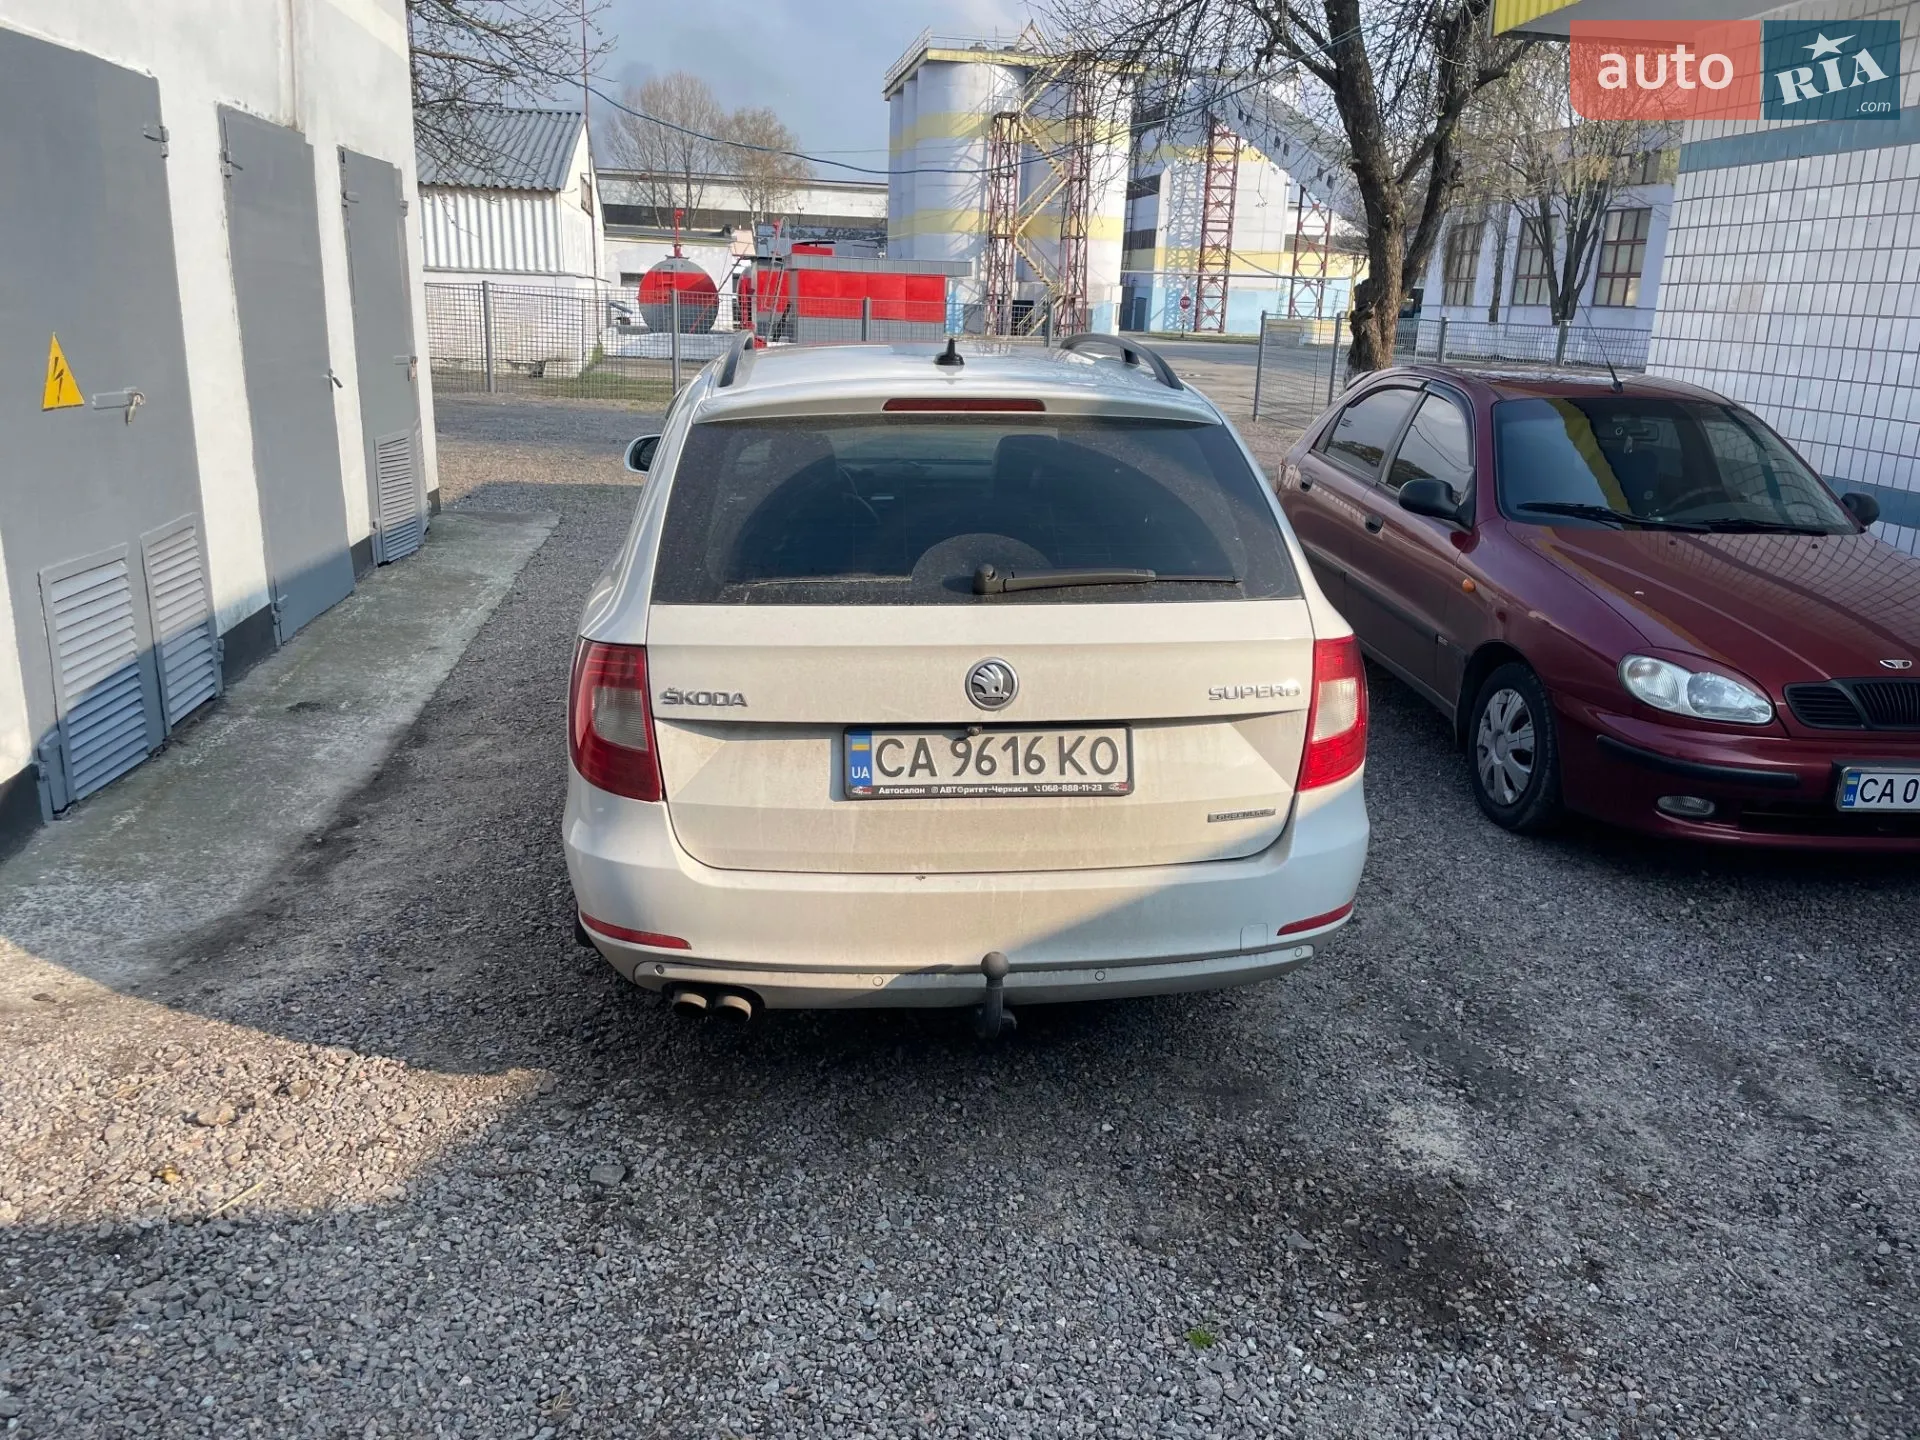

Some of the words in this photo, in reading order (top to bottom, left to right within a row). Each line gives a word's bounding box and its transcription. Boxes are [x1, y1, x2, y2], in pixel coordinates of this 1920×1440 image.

[660, 687, 748, 707] ŠKODA
[875, 737, 938, 778] CA
[950, 735, 1047, 777] 9616
[1058, 735, 1119, 776] KO
[851, 766, 870, 779] UA
[878, 786, 926, 795] Автосалон
[1041, 784, 1103, 792] 068-888-11-23
[1843, 793, 1855, 802] UA
[1859, 778, 1895, 803] CA
